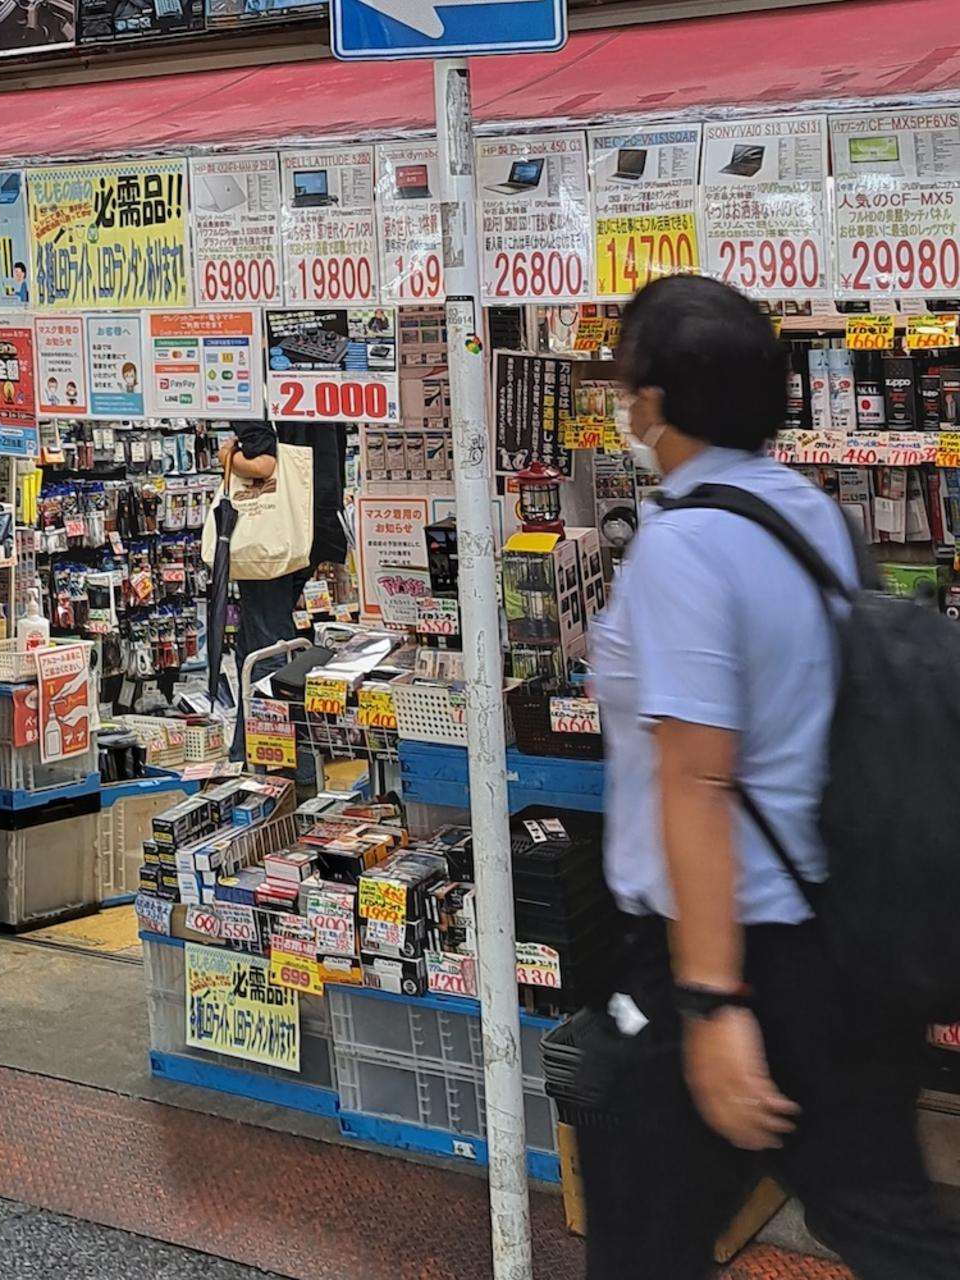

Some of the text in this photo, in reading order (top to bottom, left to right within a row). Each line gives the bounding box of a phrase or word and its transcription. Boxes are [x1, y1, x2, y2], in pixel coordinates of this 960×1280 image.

[708, 126, 737, 139] SONY
[94, 173, 184, 230] 必需品!!
[839, 191, 955, 210] 人気のCF-MX5
[170, 379, 196, 389] PayPay
[164, 395, 179, 403] LINE
[365, 508, 423, 521] マスク着用の
[375, 523, 413, 535] お知らせ
[255, 747, 284, 762] 999
[223, 923, 251, 938] 550
[280, 966, 311, 987] 699
